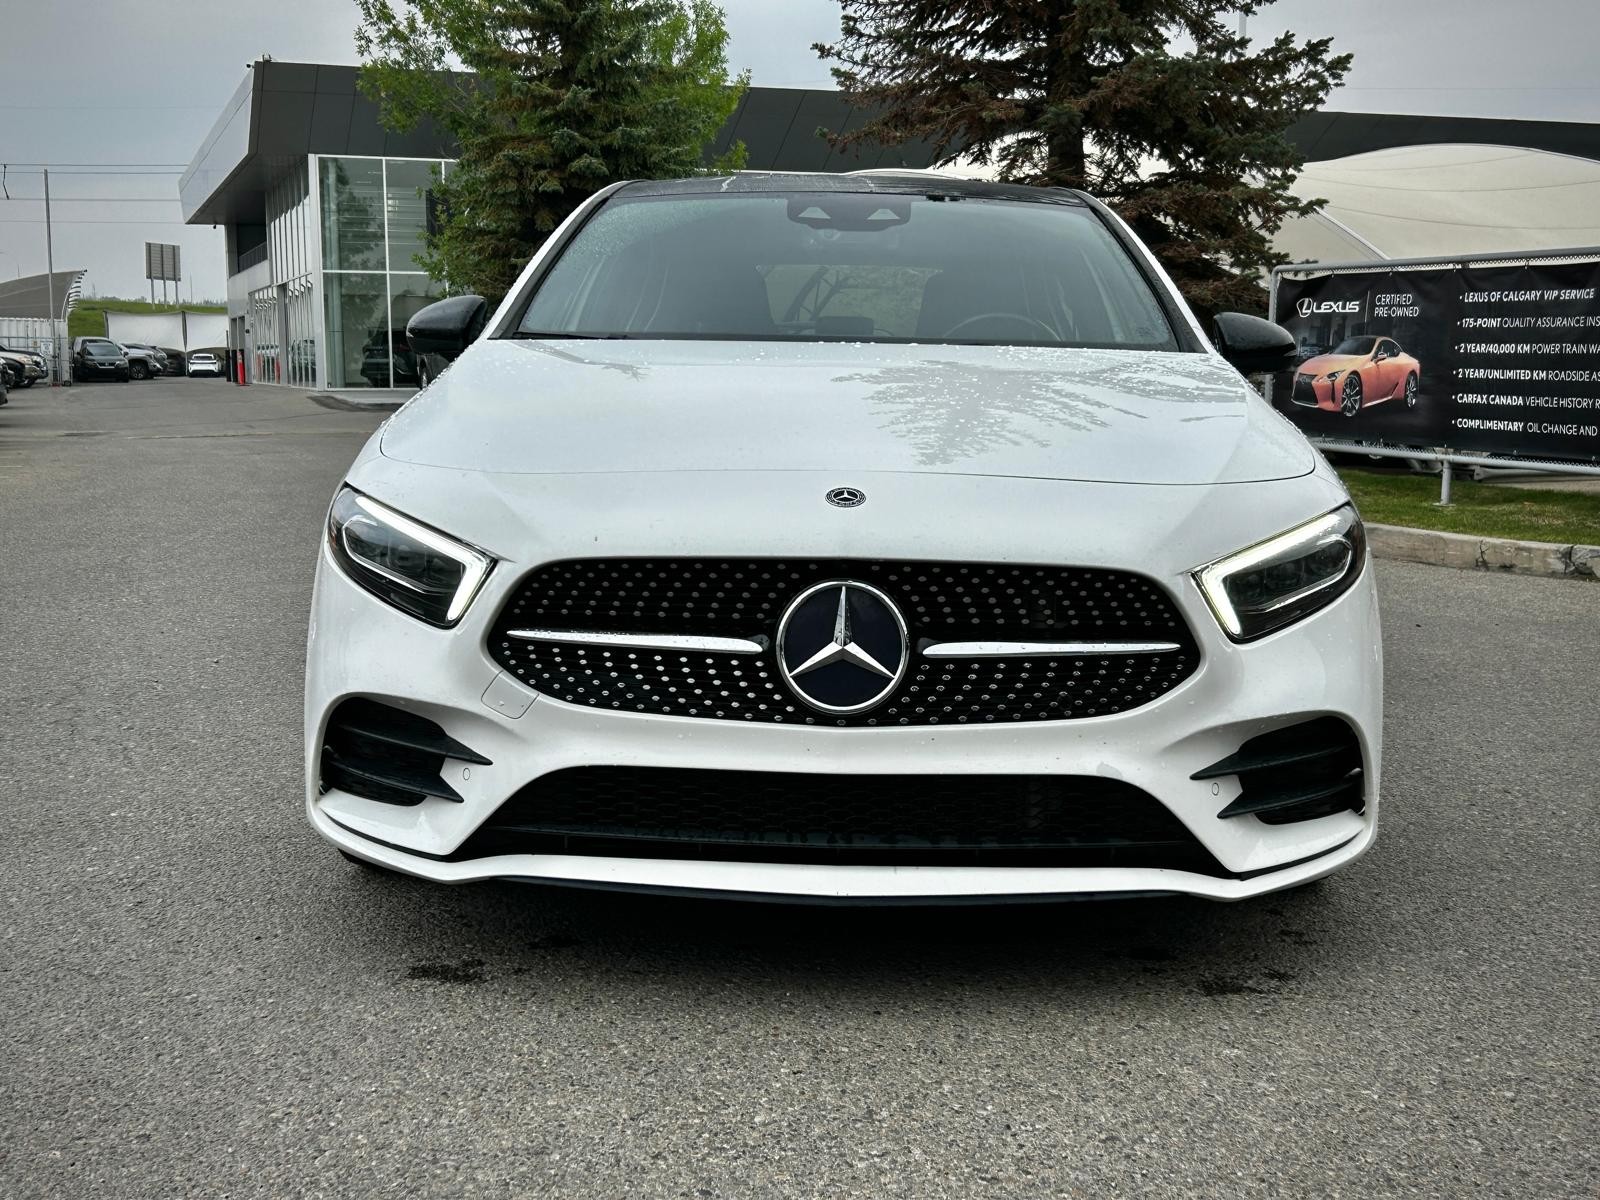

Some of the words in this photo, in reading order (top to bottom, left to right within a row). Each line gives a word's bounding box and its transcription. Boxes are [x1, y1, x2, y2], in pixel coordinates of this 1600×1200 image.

[1375, 294, 1413, 306] CERTIFIED
[1464, 291, 1488, 302] LEXUS
[1490, 292, 1500, 302] OF
[1502, 290, 1541, 301] CALGARY
[1544, 289, 1558, 300] VIP
[1560, 288, 1595, 300] SERVICE
[1312, 302, 1360, 312] LEXUS
[1374, 306, 1420, 317] PRE-OWNED
[1462, 318, 1501, 328] 175-POINT
[1502, 318, 1536, 328] QUALITY
[1536, 316, 1584, 328] ASSURANCE
[1460, 344, 1465, 353] 2
[1466, 344, 1516, 354] YEAR/40,000
[1517, 344, 1530, 354] KM
[1532, 344, 1560, 354] POWER
[1562, 344, 1587, 354] TRAIN
[1458, 369, 1462, 378] 2
[1464, 369, 1531, 380] YEAR/UNLIMITED
[1532, 370, 1546, 380] KM
[1548, 370, 1590, 381] ROADSIDE
[1457, 394, 1488, 404] CARFAX
[1489, 395, 1524, 406] CANADA
[1525, 396, 1558, 408] VEHICLE
[1560, 398, 1594, 408] HISTORY
[1456, 418, 1524, 432] COMPLIMENTARY
[1526, 422, 1540, 432] OIL
[1542, 423, 1578, 435] CHANGE
[1578, 426, 1598, 436] AND
